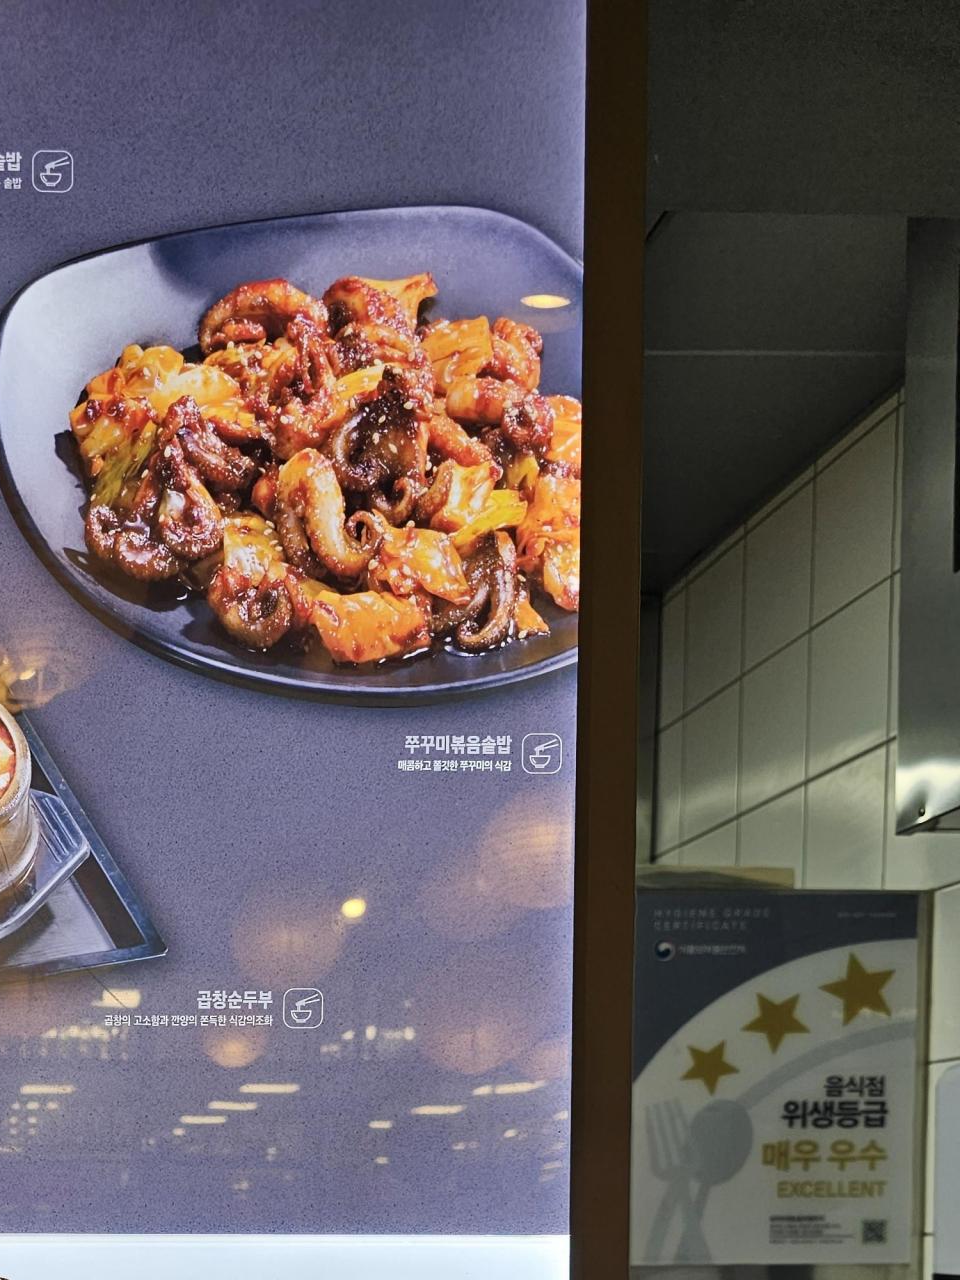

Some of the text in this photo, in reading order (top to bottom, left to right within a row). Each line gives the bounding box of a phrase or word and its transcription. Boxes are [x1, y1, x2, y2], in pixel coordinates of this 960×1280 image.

[3, 177, 22, 189] 솥밥
[405, 735, 512, 754] 쭈꾸미볶음솥밥
[398, 760, 512, 771] 매콤하고 쫄깃한 쭈꾸미의 식감
[197, 990, 273, 1010] 곱창순두부
[825, 1075, 886, 1098] 음식점
[782, 1100, 888, 1129] 위생등급
[762, 1140, 888, 1172] 매우 우수
[777, 1181, 886, 1199] EXCELLENT
